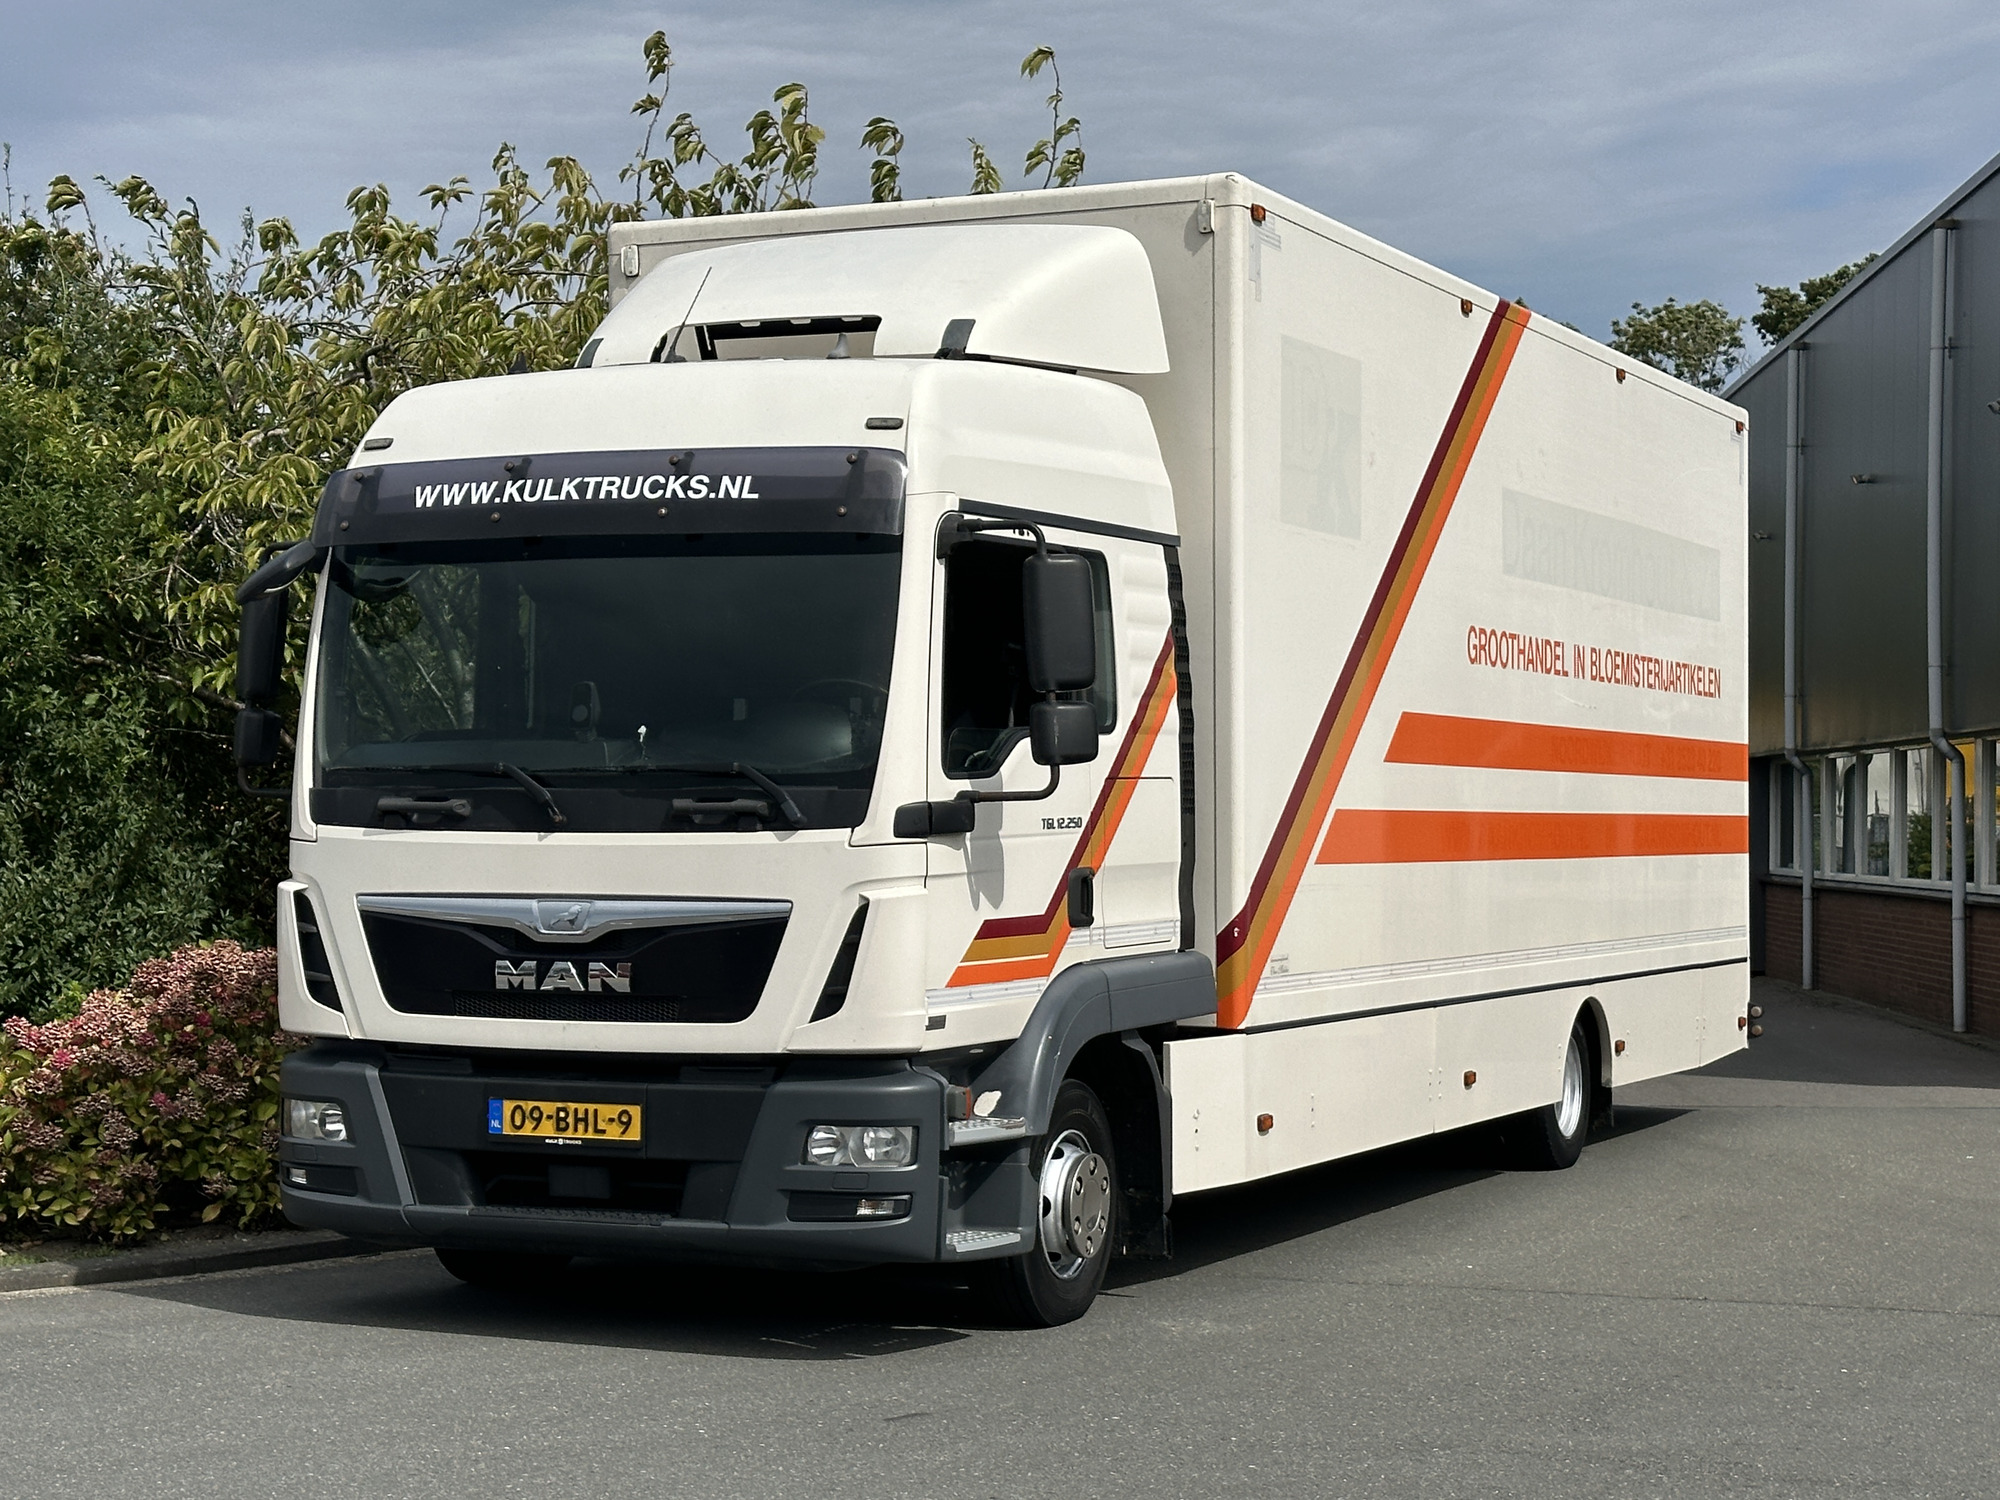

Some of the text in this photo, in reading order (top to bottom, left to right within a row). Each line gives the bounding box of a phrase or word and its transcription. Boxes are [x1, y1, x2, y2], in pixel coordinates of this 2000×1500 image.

[415, 475, 759, 508] WWW.KULKTRUCKS.NL
[1467, 625, 1721, 698] GROOTHANDEL IN BLOEMISTERIJARTIKELEN
[1041, 816, 1083, 830] TGL 12.250
[495, 960, 632, 992] MAN
[492, 1104, 632, 1135] NL 09-BHL-9
